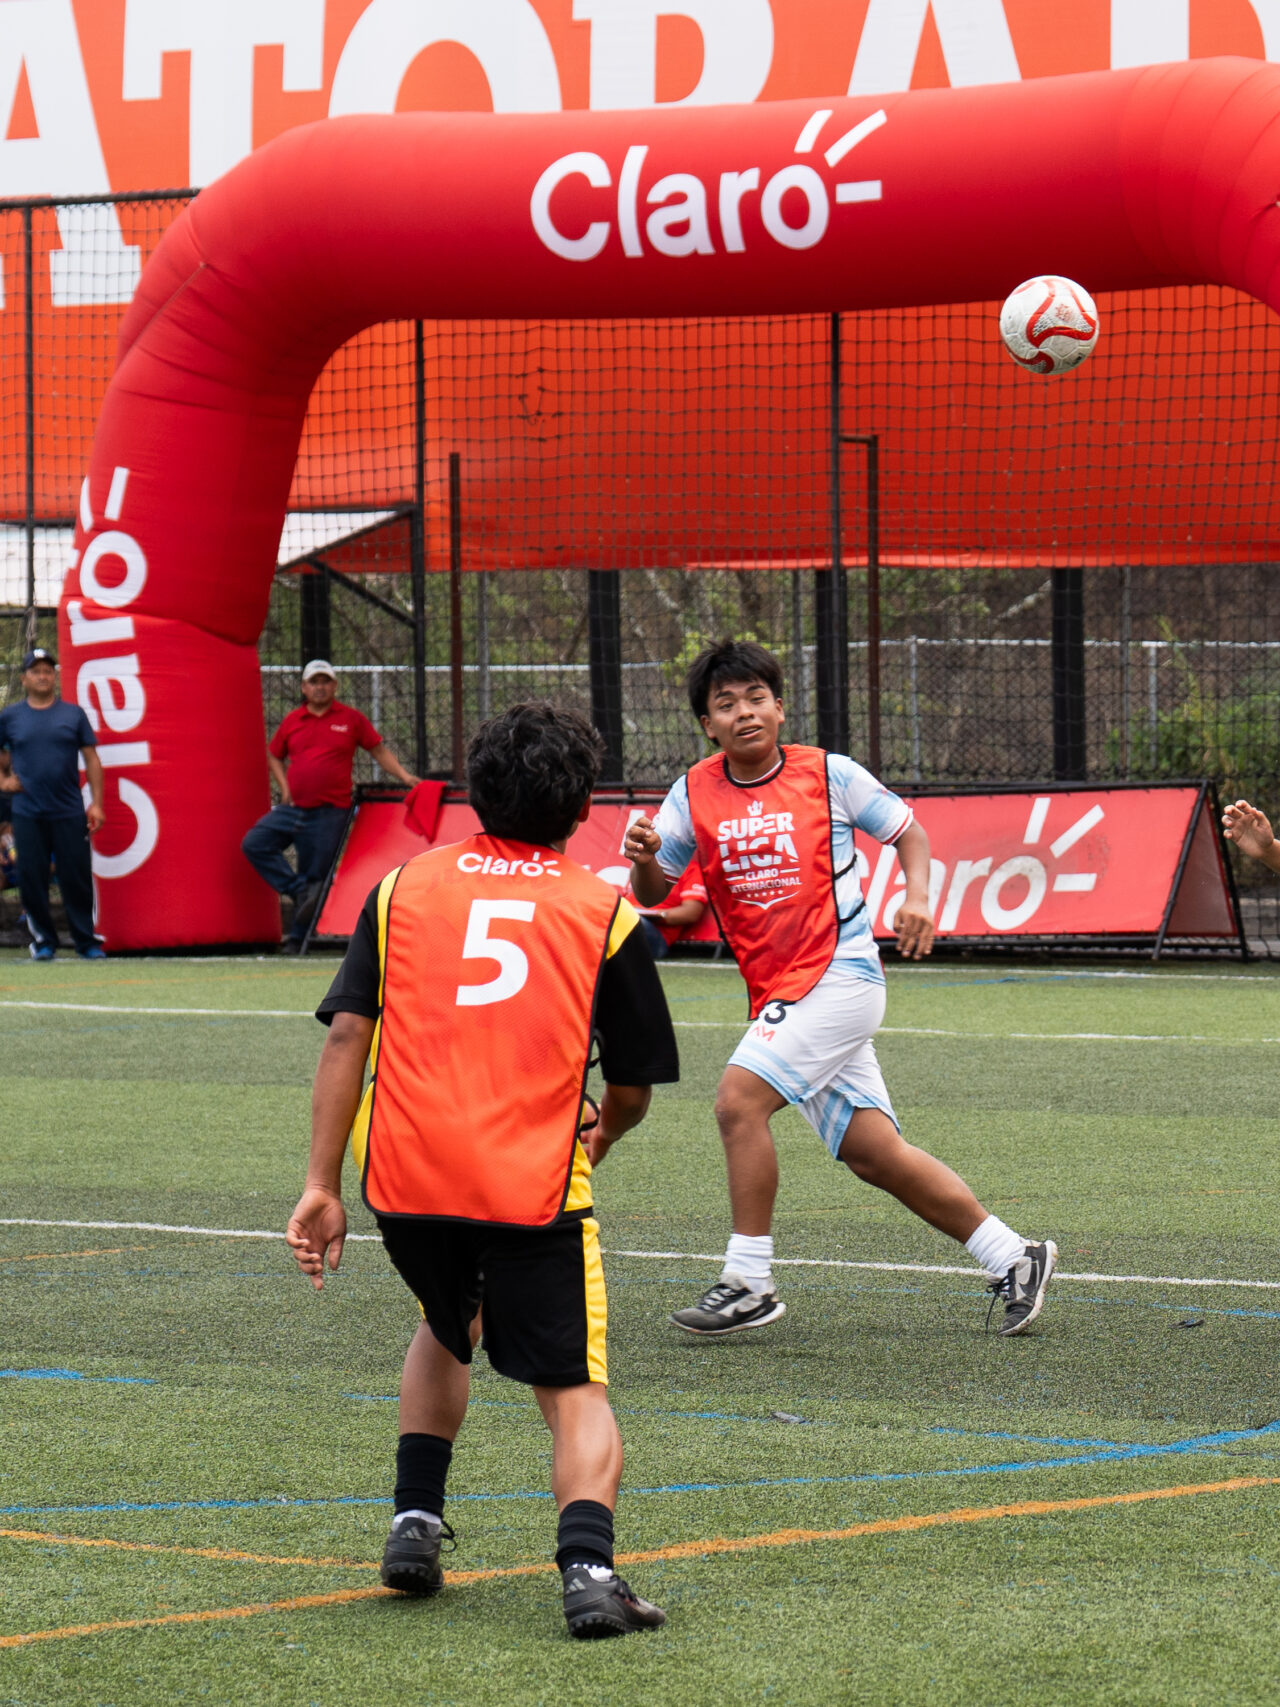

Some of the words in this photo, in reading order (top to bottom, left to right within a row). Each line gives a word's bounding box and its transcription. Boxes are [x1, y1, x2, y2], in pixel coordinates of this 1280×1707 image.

[530, 145, 830, 262] Claro
[717, 812, 795, 842] SUPER
[456, 852, 544, 877] Claro
[719, 833, 799, 872] LIGA
[745, 867, 779, 881] CLARO
[455, 898, 537, 1006] 5
